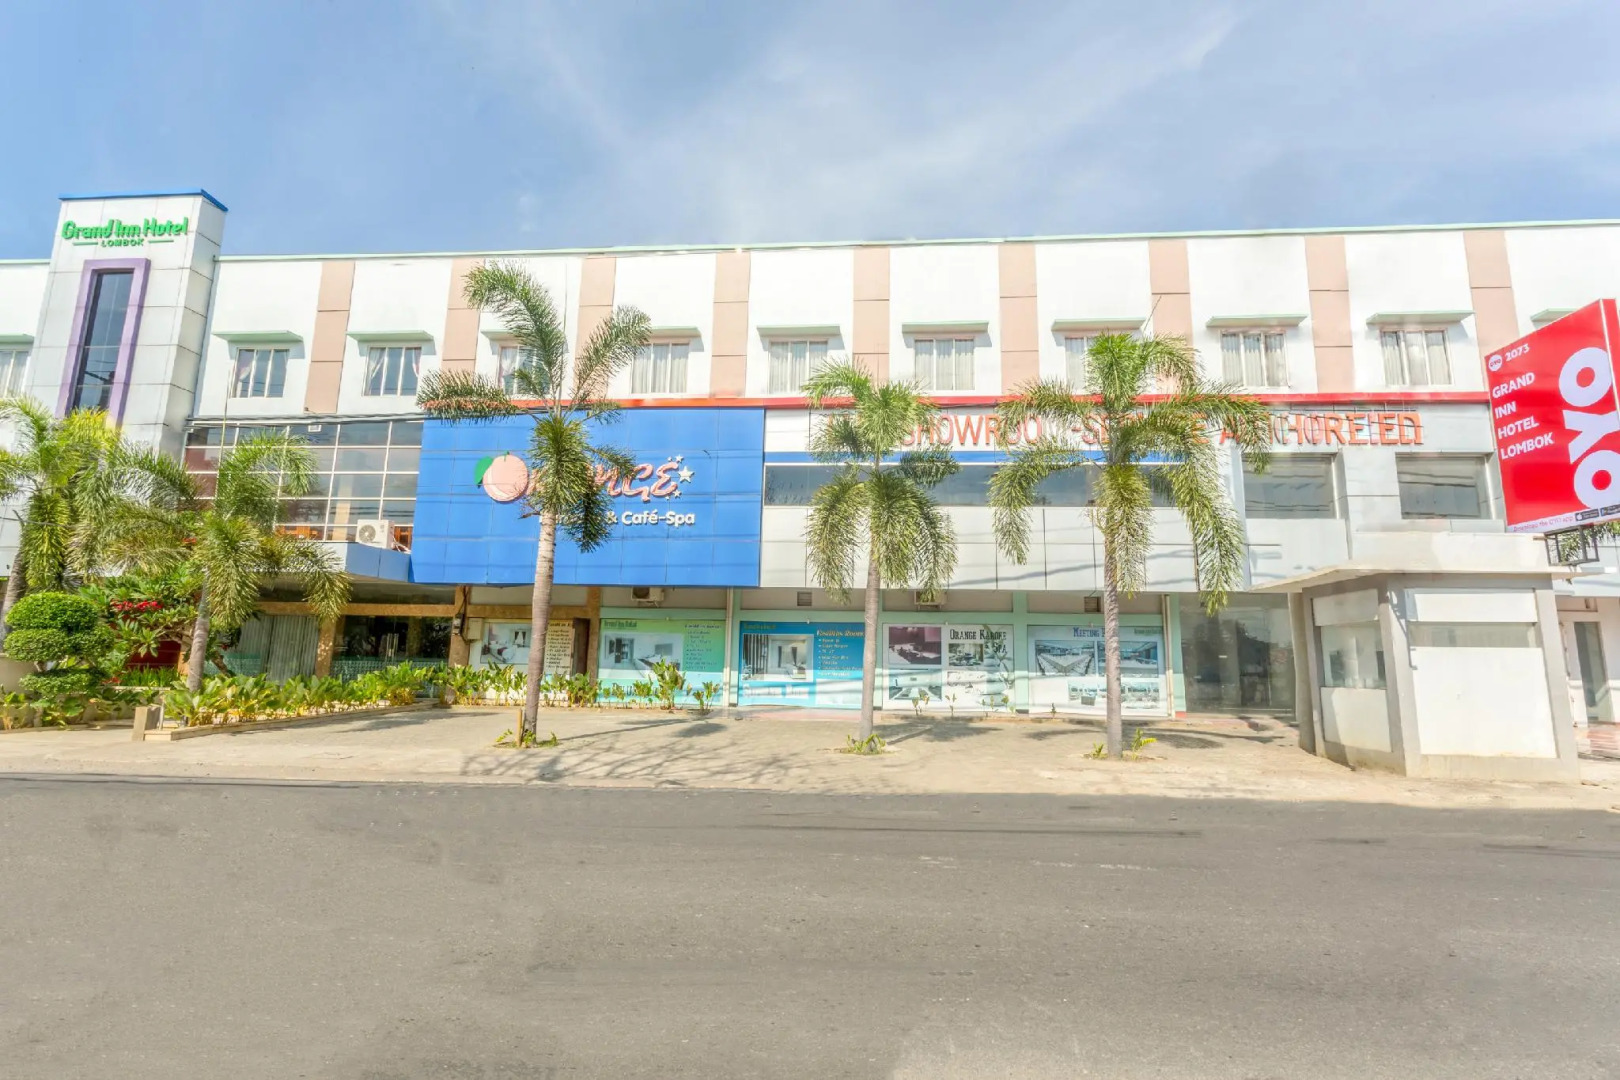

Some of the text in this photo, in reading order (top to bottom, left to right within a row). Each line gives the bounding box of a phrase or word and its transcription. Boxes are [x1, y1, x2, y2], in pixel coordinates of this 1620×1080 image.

[62, 217, 189, 239] Grand Inn Hotel
[101, 238, 144, 248] LOMBOK
[1505, 343, 1530, 362] 2073
[1492, 372, 1535, 399] GRAND
[1494, 401, 1517, 419] INN
[1498, 416, 1540, 440] HOTEL
[1559, 347, 1620, 511] OYO
[1500, 432, 1555, 460] LOMBOK
[621, 509, 695, 527] Café-Spa
[949, 629, 977, 640] ORANGE
